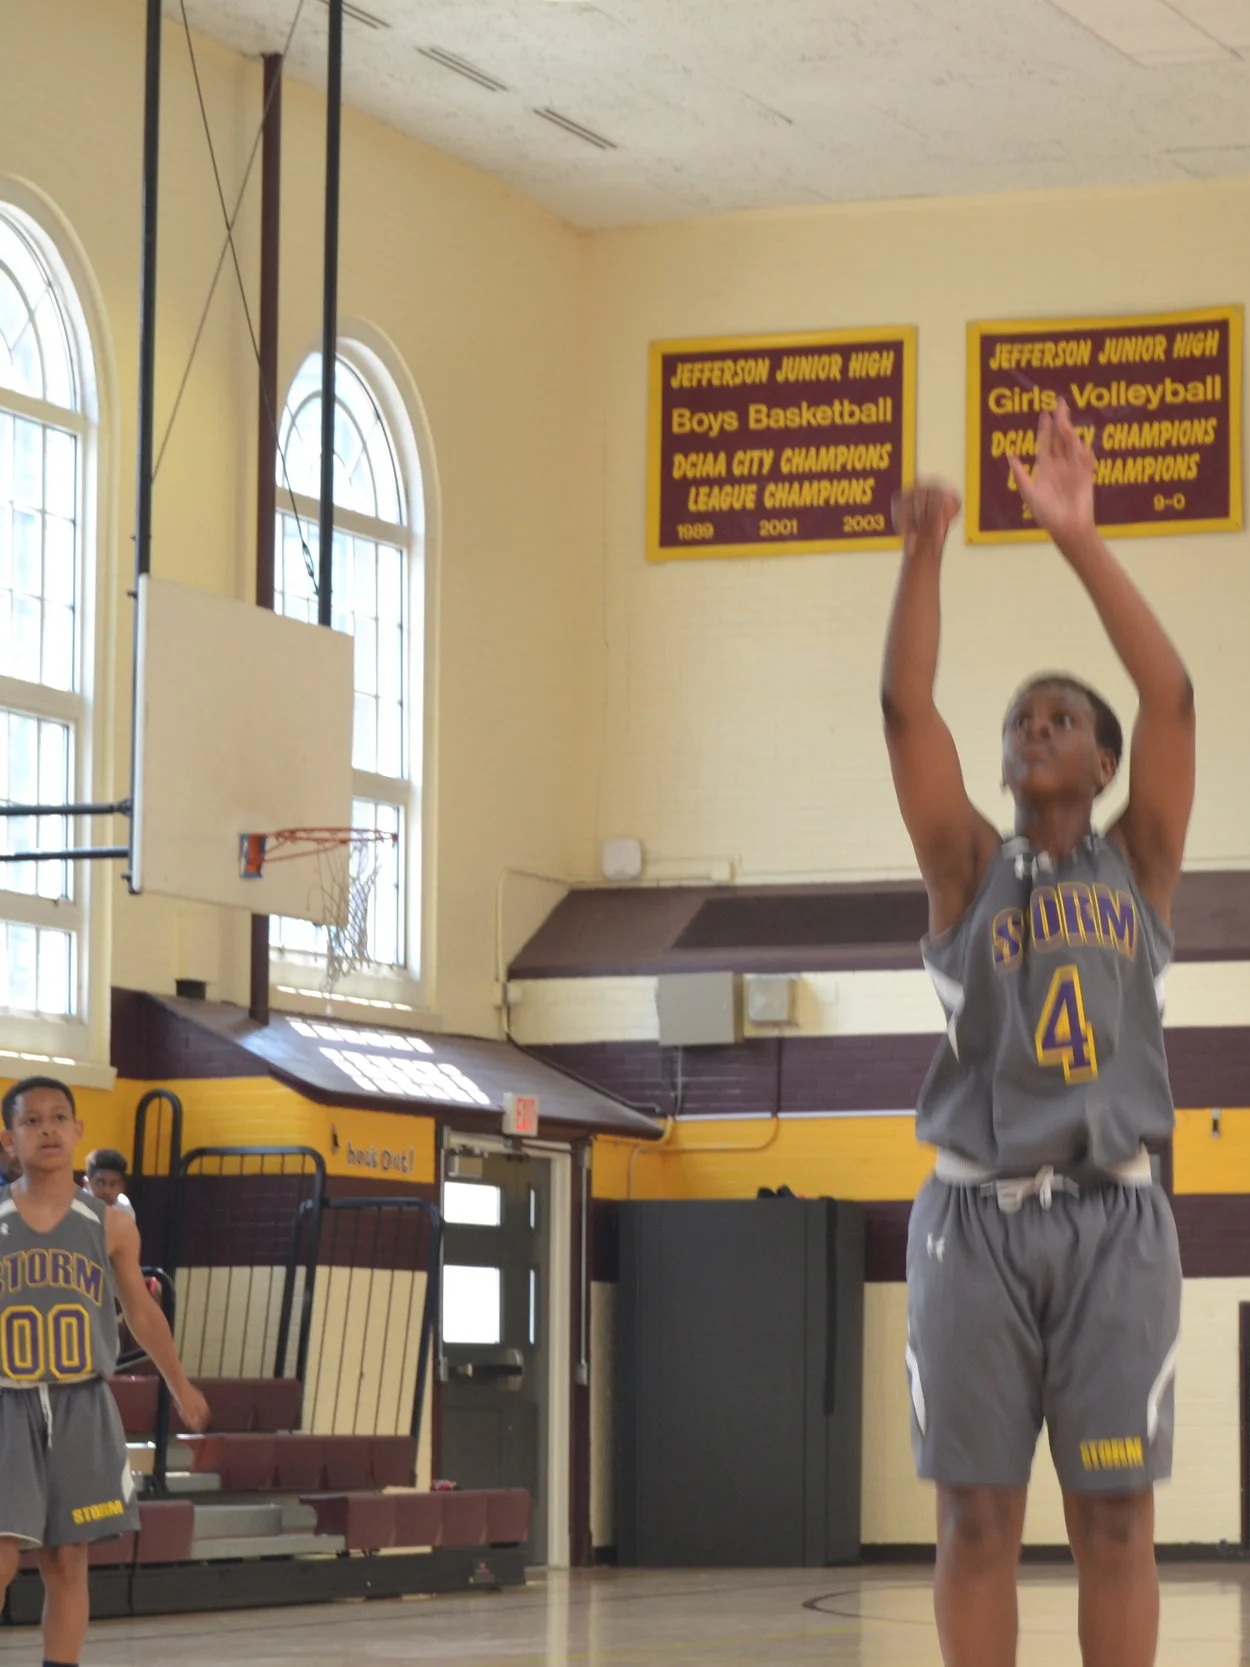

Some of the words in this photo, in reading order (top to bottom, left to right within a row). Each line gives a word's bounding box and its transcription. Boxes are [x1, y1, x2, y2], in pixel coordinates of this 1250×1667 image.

[670, 357, 770, 390] JEFFERSON
[776, 353, 843, 383] JUNIOR
[849, 350, 895, 379] HIGH
[989, 339, 1092, 371] JEFFERSON
[1098, 334, 1167, 365] JUNIOR
[1173, 329, 1220, 359] HIGH
[988, 385, 1058, 415] Girls
[1070, 375, 1221, 410] Volleyball
[671, 407, 739, 438] Boys
[748, 397, 892, 430] Basketball
[991, 429, 1039, 458] DCIA
[1102, 417, 1217, 451] CHAMPIONS
[672, 451, 727, 479] DCIAA
[732, 449, 774, 477] CITY
[780, 443, 892, 475] CHAMPIONS
[1093, 453, 1200, 486] HAMPIONS
[688, 483, 757, 512] LEAGUE
[763, 477, 875, 509] CHAMPIONS
[1153, 493, 1186, 512] 9-0
[759, 518, 798, 537] 2001
[843, 514, 885, 532] 2003
[992, 881, 1137, 975] SORM
[1034, 964, 1099, 1085] 4
[0, 1248, 104, 1306] TORM
[0, 1304, 92, 1380] 00
[1080, 1436, 1144, 1472] STORM
[71, 1499, 124, 1525] STORM
